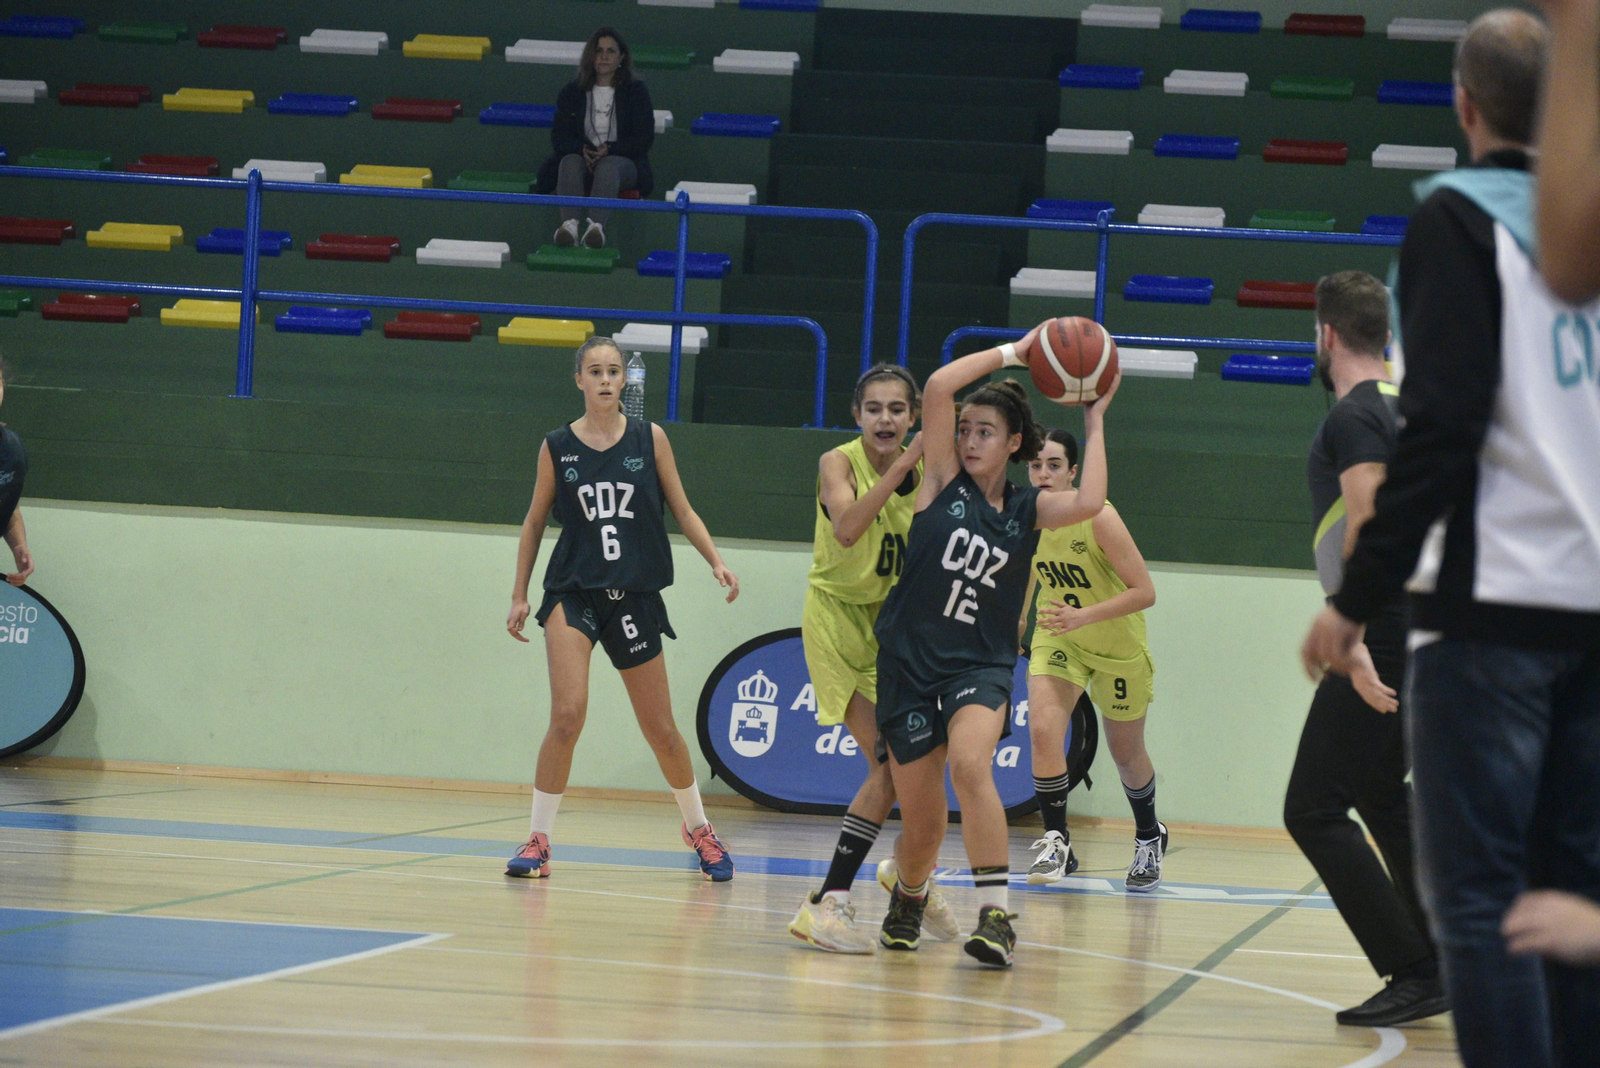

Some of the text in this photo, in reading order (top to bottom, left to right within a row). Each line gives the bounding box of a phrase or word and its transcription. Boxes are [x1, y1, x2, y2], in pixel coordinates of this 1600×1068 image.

[1553, 312, 1600, 388] CD
[577, 481, 635, 522] CDZ
[601, 524, 621, 561] 6
[876, 532, 908, 576] GN
[941, 527, 1009, 589] CDZ
[1036, 561, 1092, 589] GND
[943, 579, 979, 625] 12
[621, 614, 639, 639] 6
[1114, 677, 1127, 700] 9
[815, 725, 859, 756] de
